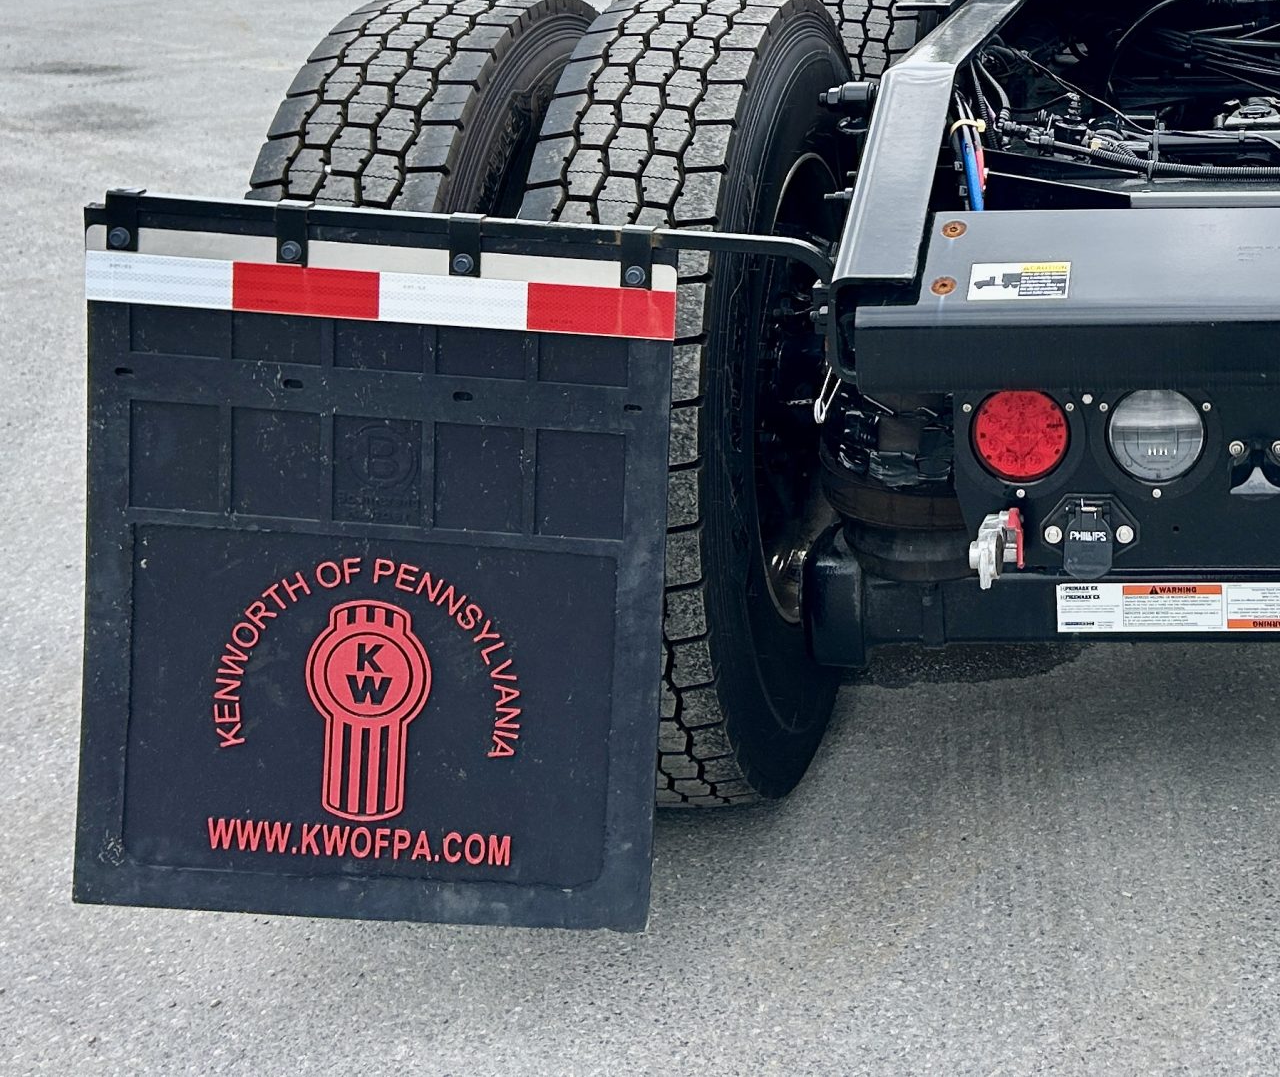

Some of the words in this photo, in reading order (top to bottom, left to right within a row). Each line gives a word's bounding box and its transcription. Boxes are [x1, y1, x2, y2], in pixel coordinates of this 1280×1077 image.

[1069, 530, 1107, 542] PHILLIPS
[1159, 586, 1197, 594] WARNING
[213, 572, 311, 748] KENWORTH
[315, 557, 361, 589] OF
[373, 558, 521, 758] PENNSYLVANIA
[356, 642, 385, 673] K
[345, 674, 393, 706] W
[207, 817, 512, 866] WWW.KWOFPA.COM
